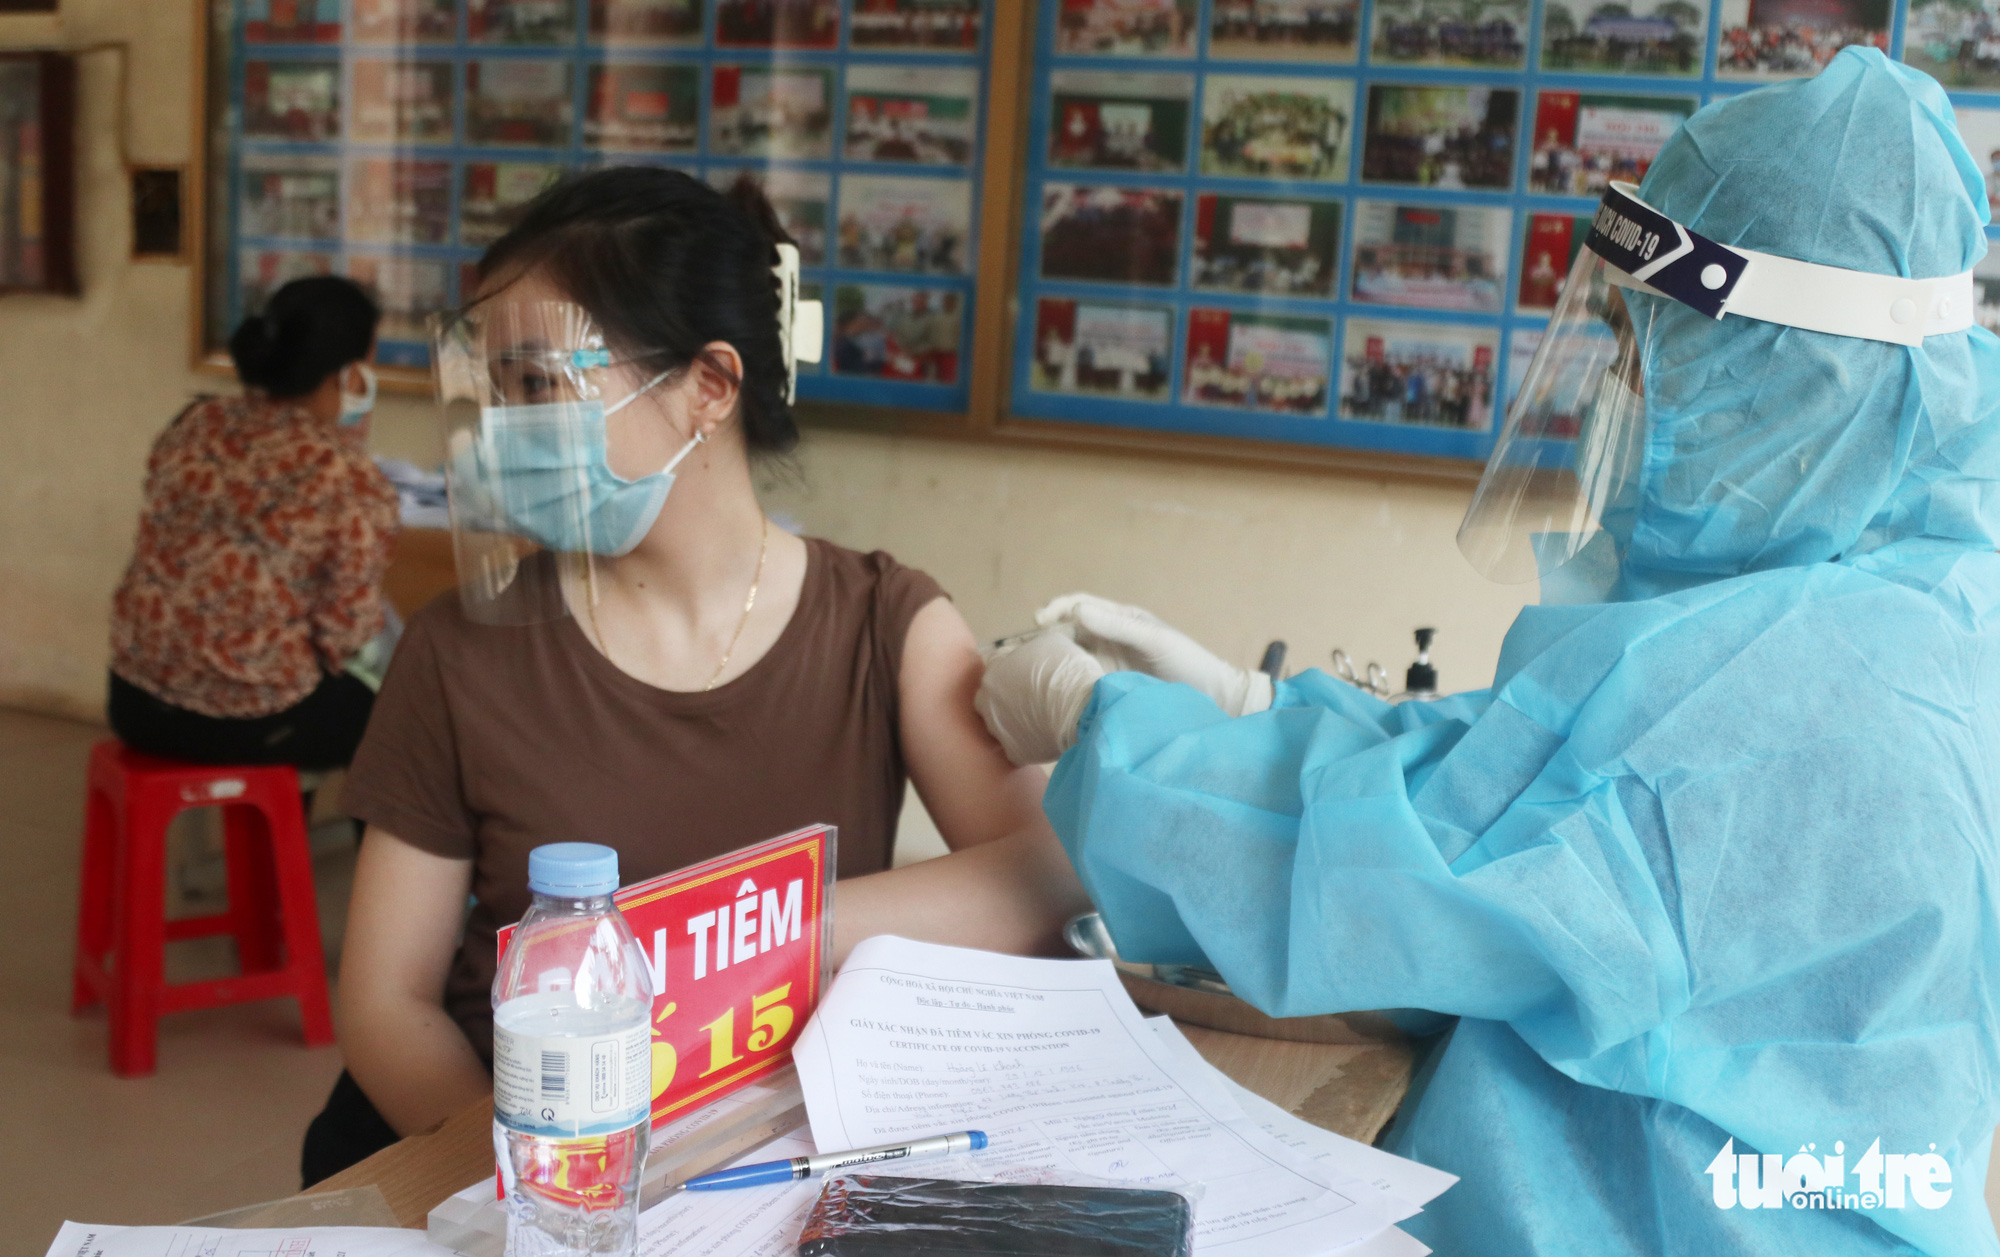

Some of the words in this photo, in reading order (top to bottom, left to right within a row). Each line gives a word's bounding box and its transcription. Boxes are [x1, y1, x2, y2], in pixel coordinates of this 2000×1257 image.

[1610, 215, 1660, 261] COVID-19
[687, 878, 803, 981] TIÊM
[880, 975, 904, 988] CỘNG
[699, 982, 794, 1079] 15
[1055, 1028, 1101, 1038] COVID-19
[890, 1040, 949, 1052] CERTIFICATE
[964, 1046, 1004, 1054] COVID-19
